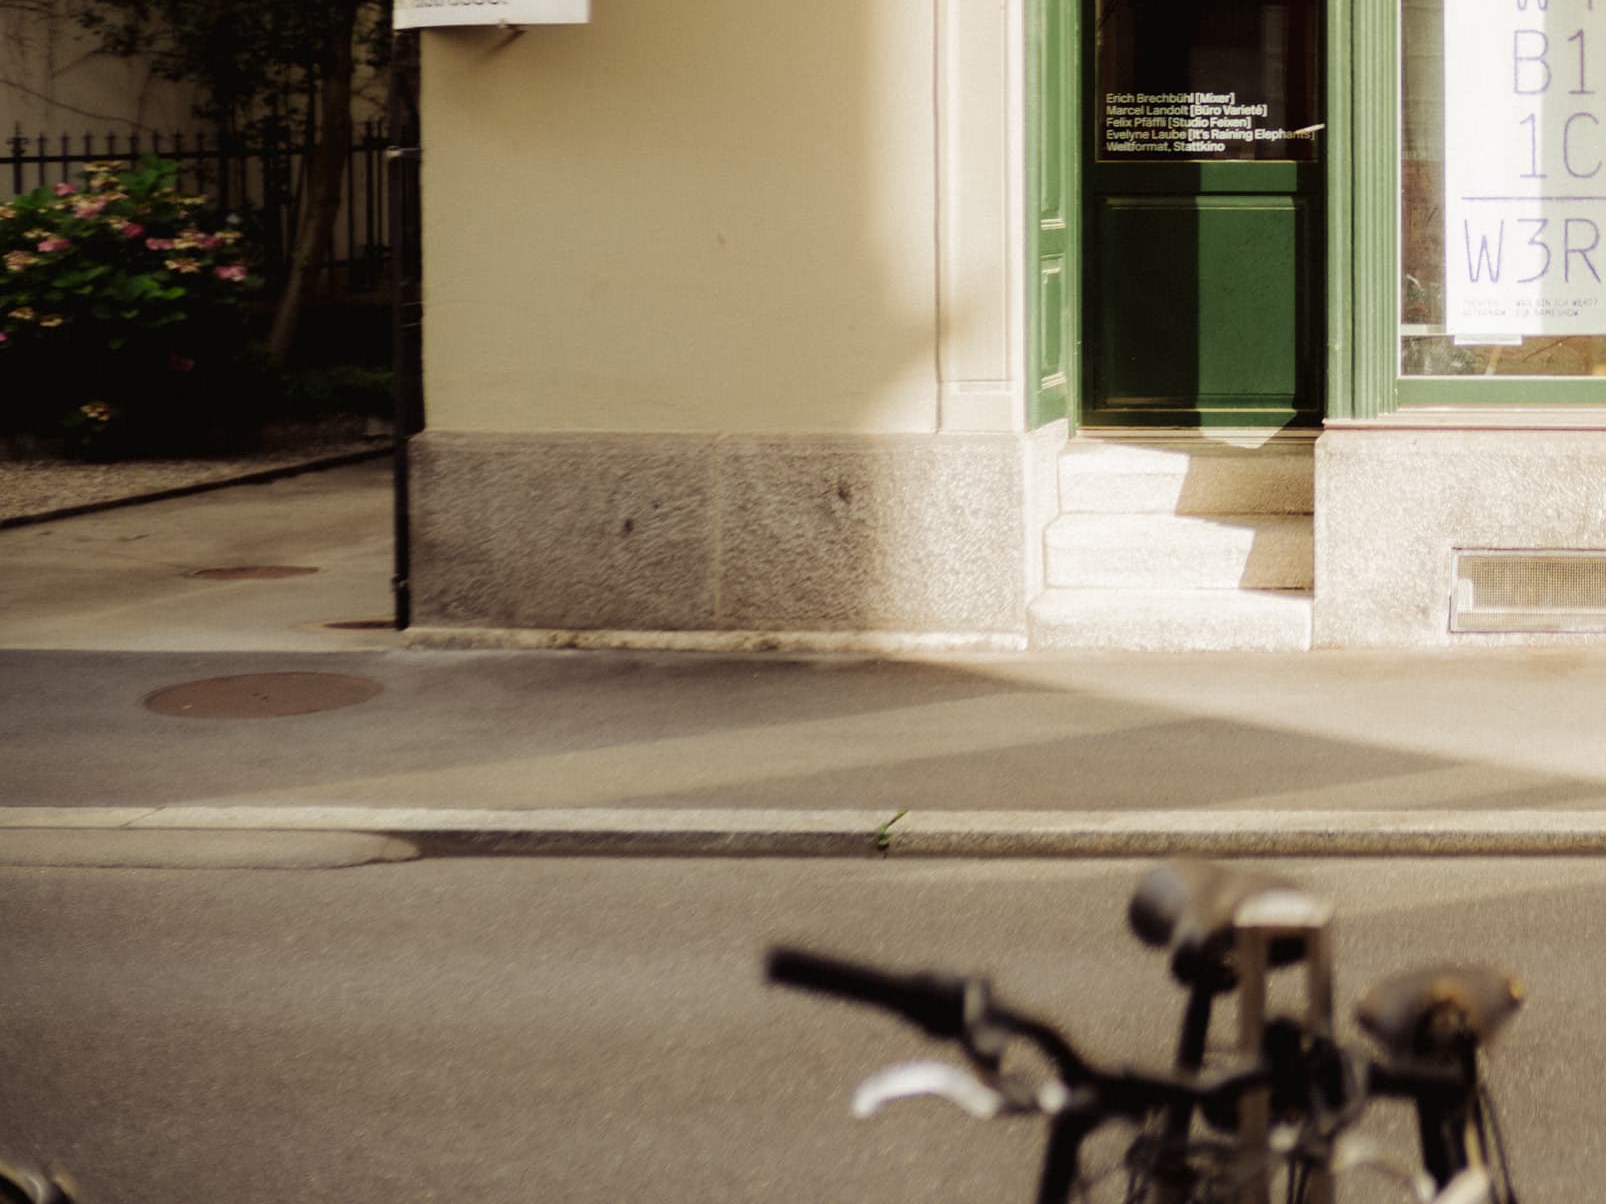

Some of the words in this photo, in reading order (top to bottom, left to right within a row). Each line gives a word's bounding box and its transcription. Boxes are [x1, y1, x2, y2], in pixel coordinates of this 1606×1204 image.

[1105, 92, 1135, 104] Erich
[1136, 92, 1194, 104] Brechbühl
[1105, 105, 1145, 115] Marcel
[1146, 105, 1189, 115] Landolt
[1190, 104, 1222, 117] [Büro
[1105, 117, 1132, 128] Felix
[1168, 117, 1209, 129] [Studio
[1105, 129, 1150, 142] Evelyne
[1151, 129, 1187, 140] Laube
[1211, 129, 1254, 142] Raining
